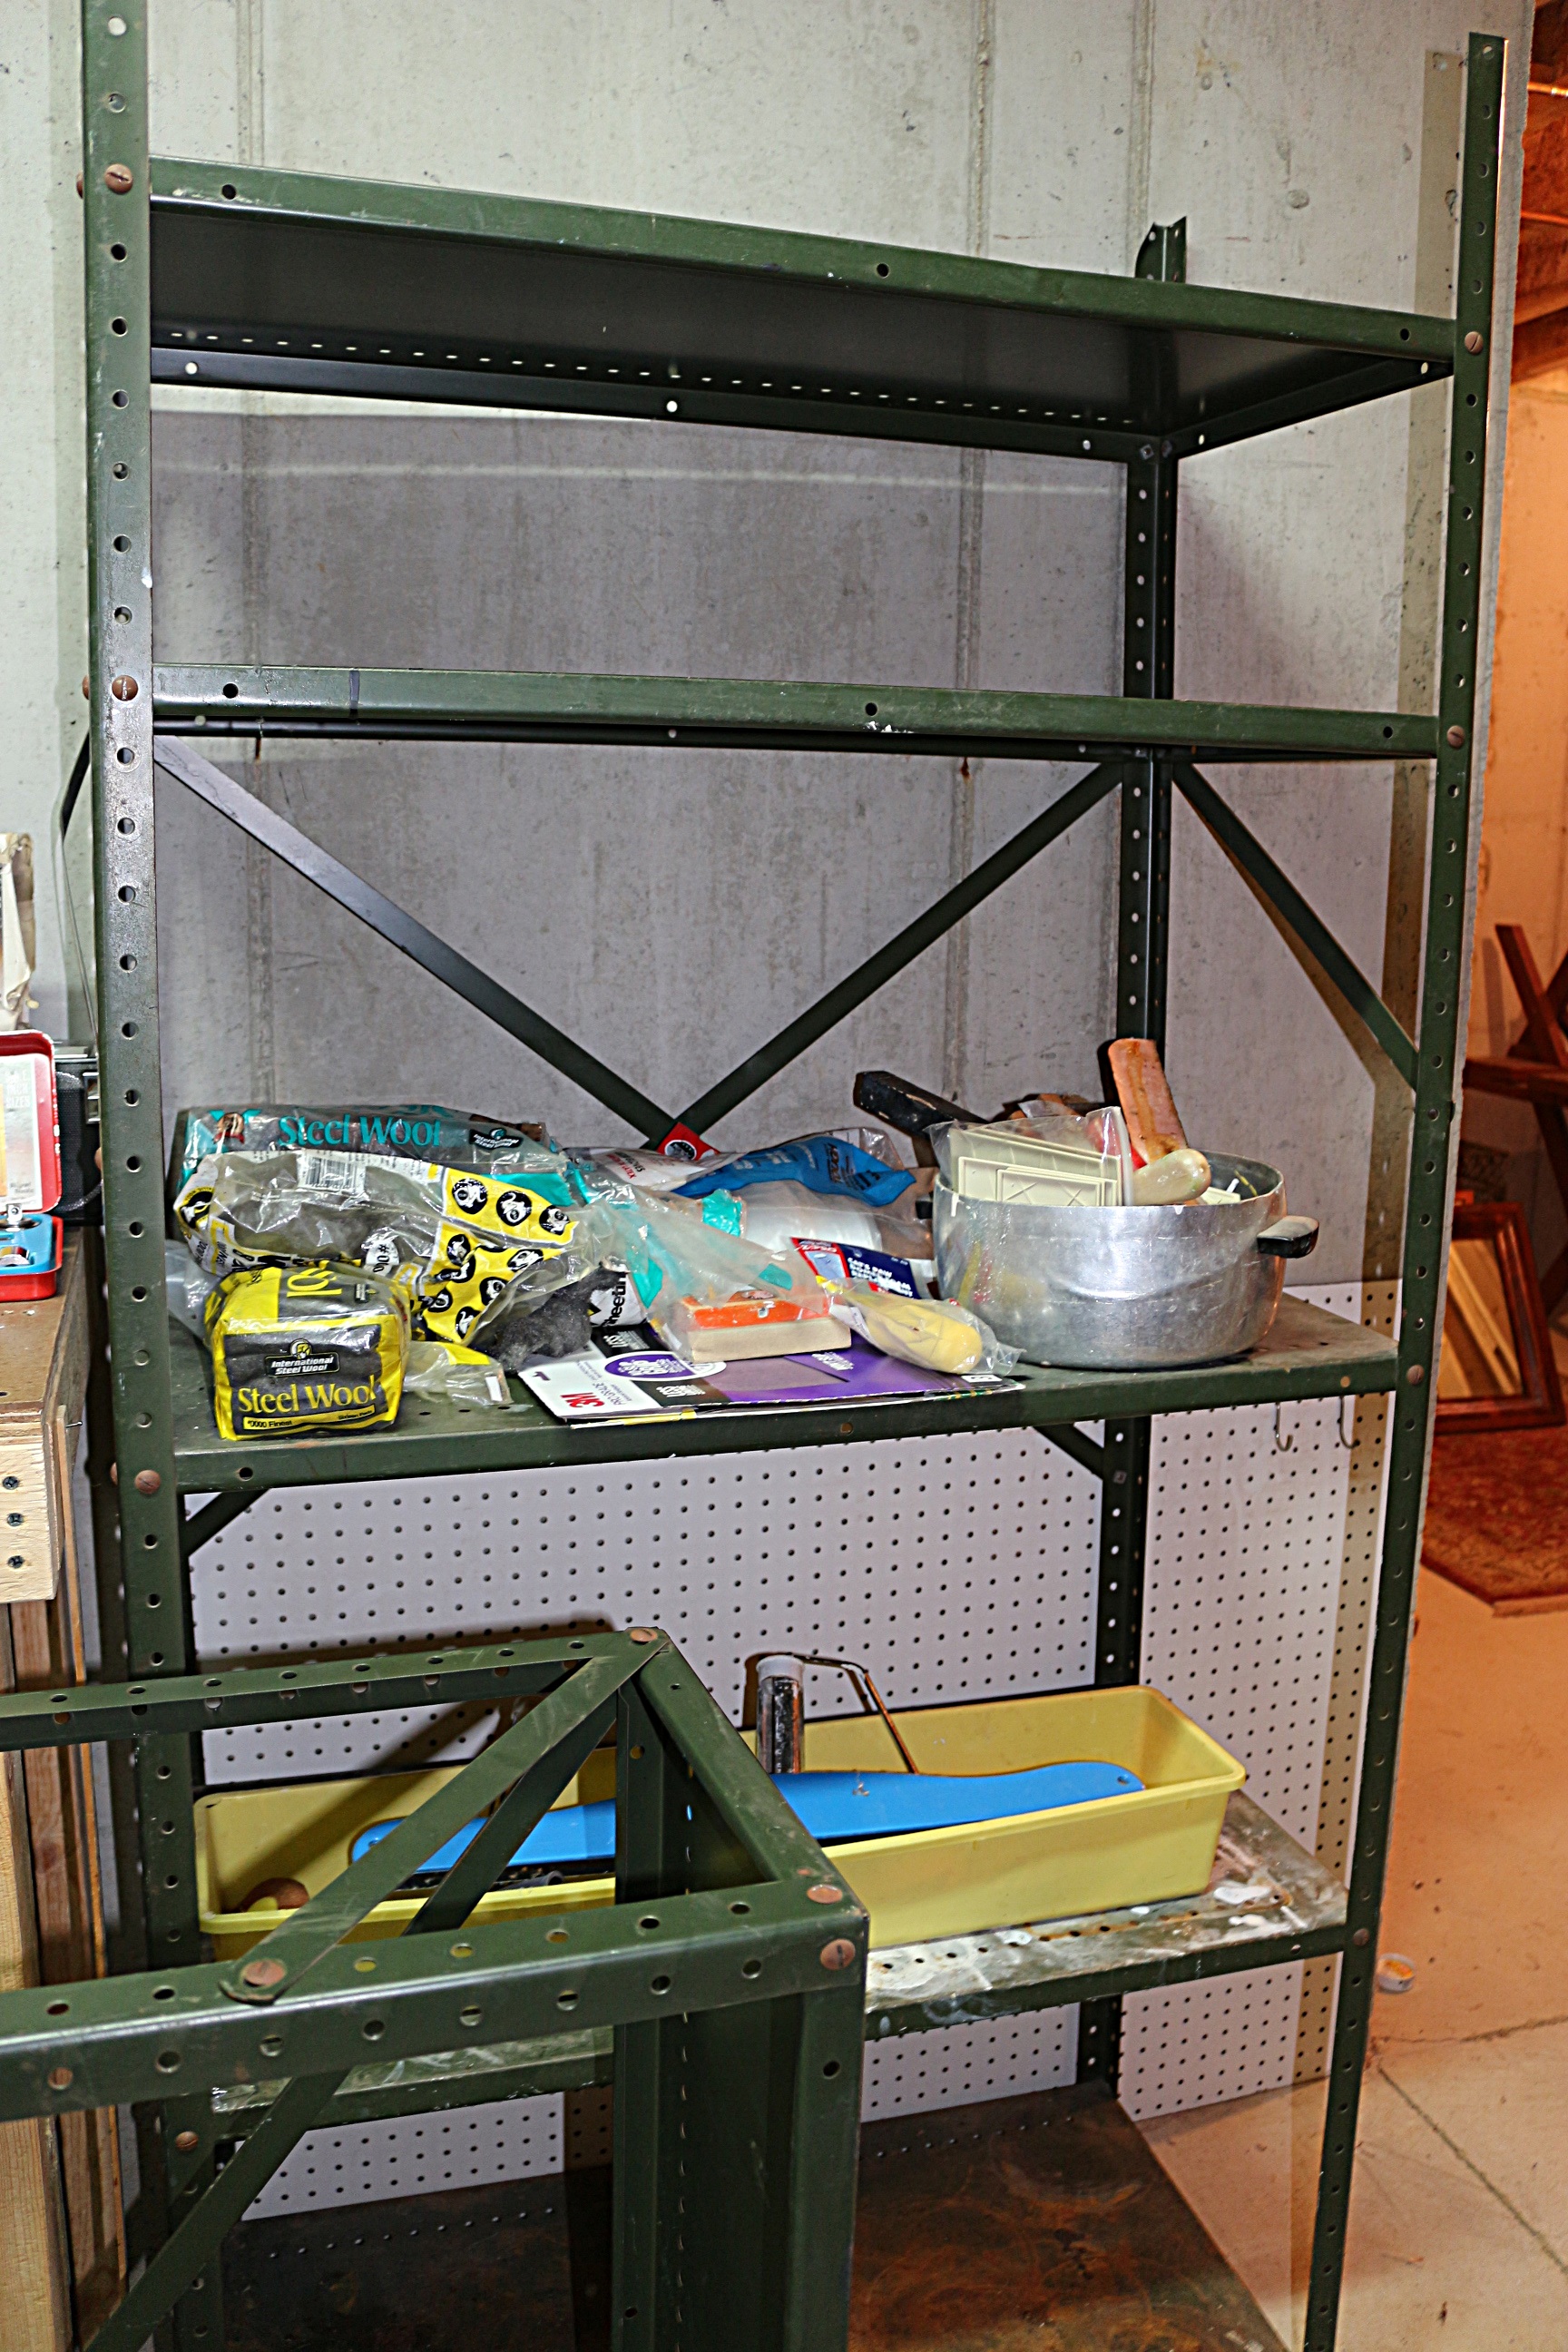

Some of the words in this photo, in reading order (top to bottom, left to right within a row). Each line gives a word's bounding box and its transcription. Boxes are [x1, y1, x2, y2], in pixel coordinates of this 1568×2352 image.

[278, 1112, 350, 1146] Steel
[359, 1115, 441, 1147] Wool
[271, 1355, 334, 1368] International
[275, 1365, 302, 1376] Steel
[302, 1363, 328, 1374] Wool
[238, 1383, 299, 1414] Steel
[304, 1374, 377, 1409] Wool
[560, 1391, 606, 1408] 3M
[269, 1420, 293, 1428] Finest
